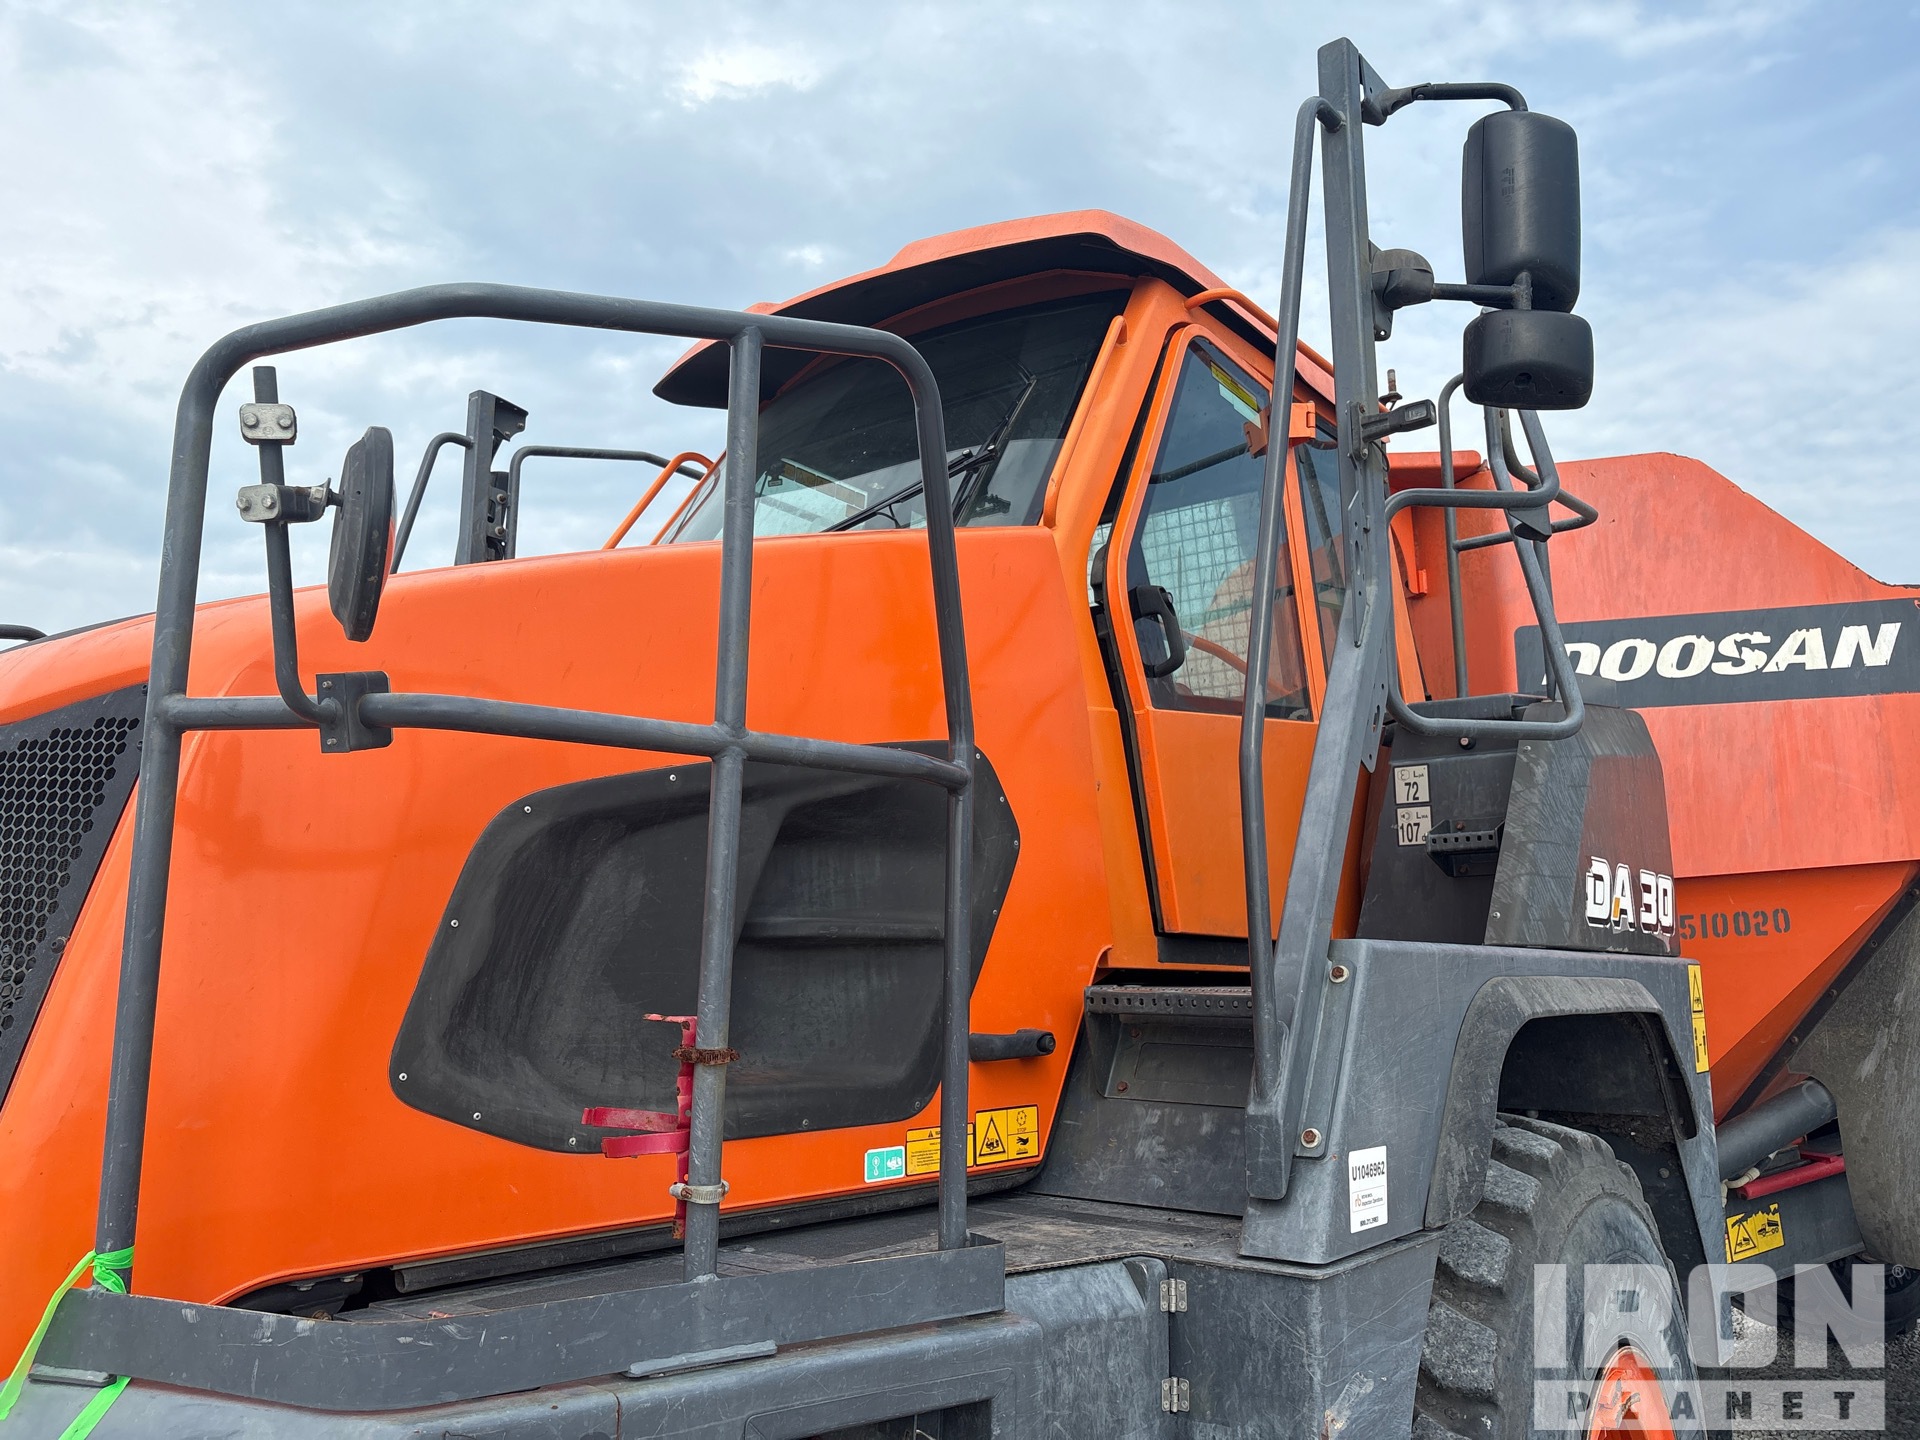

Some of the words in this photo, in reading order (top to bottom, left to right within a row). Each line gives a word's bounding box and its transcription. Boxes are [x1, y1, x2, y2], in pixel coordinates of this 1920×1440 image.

[1404, 781, 1420, 802] 72
[1400, 823, 1420, 843] 107
[1680, 908, 1791, 940] 510020
